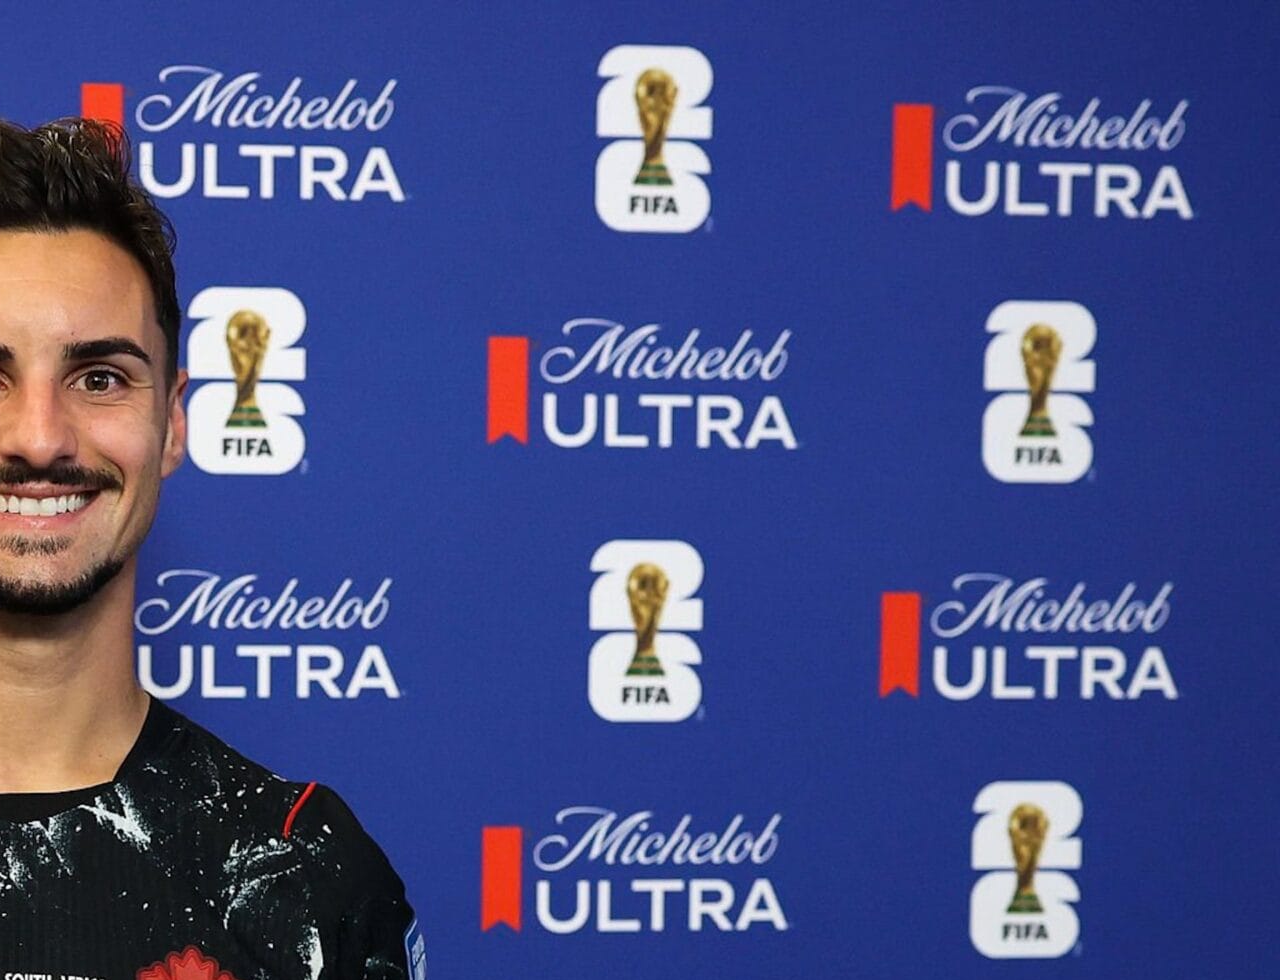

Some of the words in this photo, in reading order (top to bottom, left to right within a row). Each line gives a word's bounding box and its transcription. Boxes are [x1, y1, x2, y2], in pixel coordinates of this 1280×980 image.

[136, 66, 396, 131] Michelob
[945, 88, 1187, 151] Michelob
[140, 142, 404, 201] ULTRA
[946, 160, 1192, 219] ULTRA
[630, 195, 678, 214] FIFA
[541, 319, 790, 383] Michelob
[222, 438, 272, 456] FIFA
[543, 393, 797, 449] ULTRA
[1015, 447, 1061, 464] FIFA
[136, 570, 391, 634] Michelob
[932, 575, 1171, 637] Michelob
[139, 645, 400, 699] ULTRA
[622, 686, 670, 703] FIFA
[933, 647, 1177, 700] ULTRA
[534, 807, 780, 871] Michelob
[537, 879, 787, 933] ULTRA
[1002, 924, 1048, 939] FIFA
